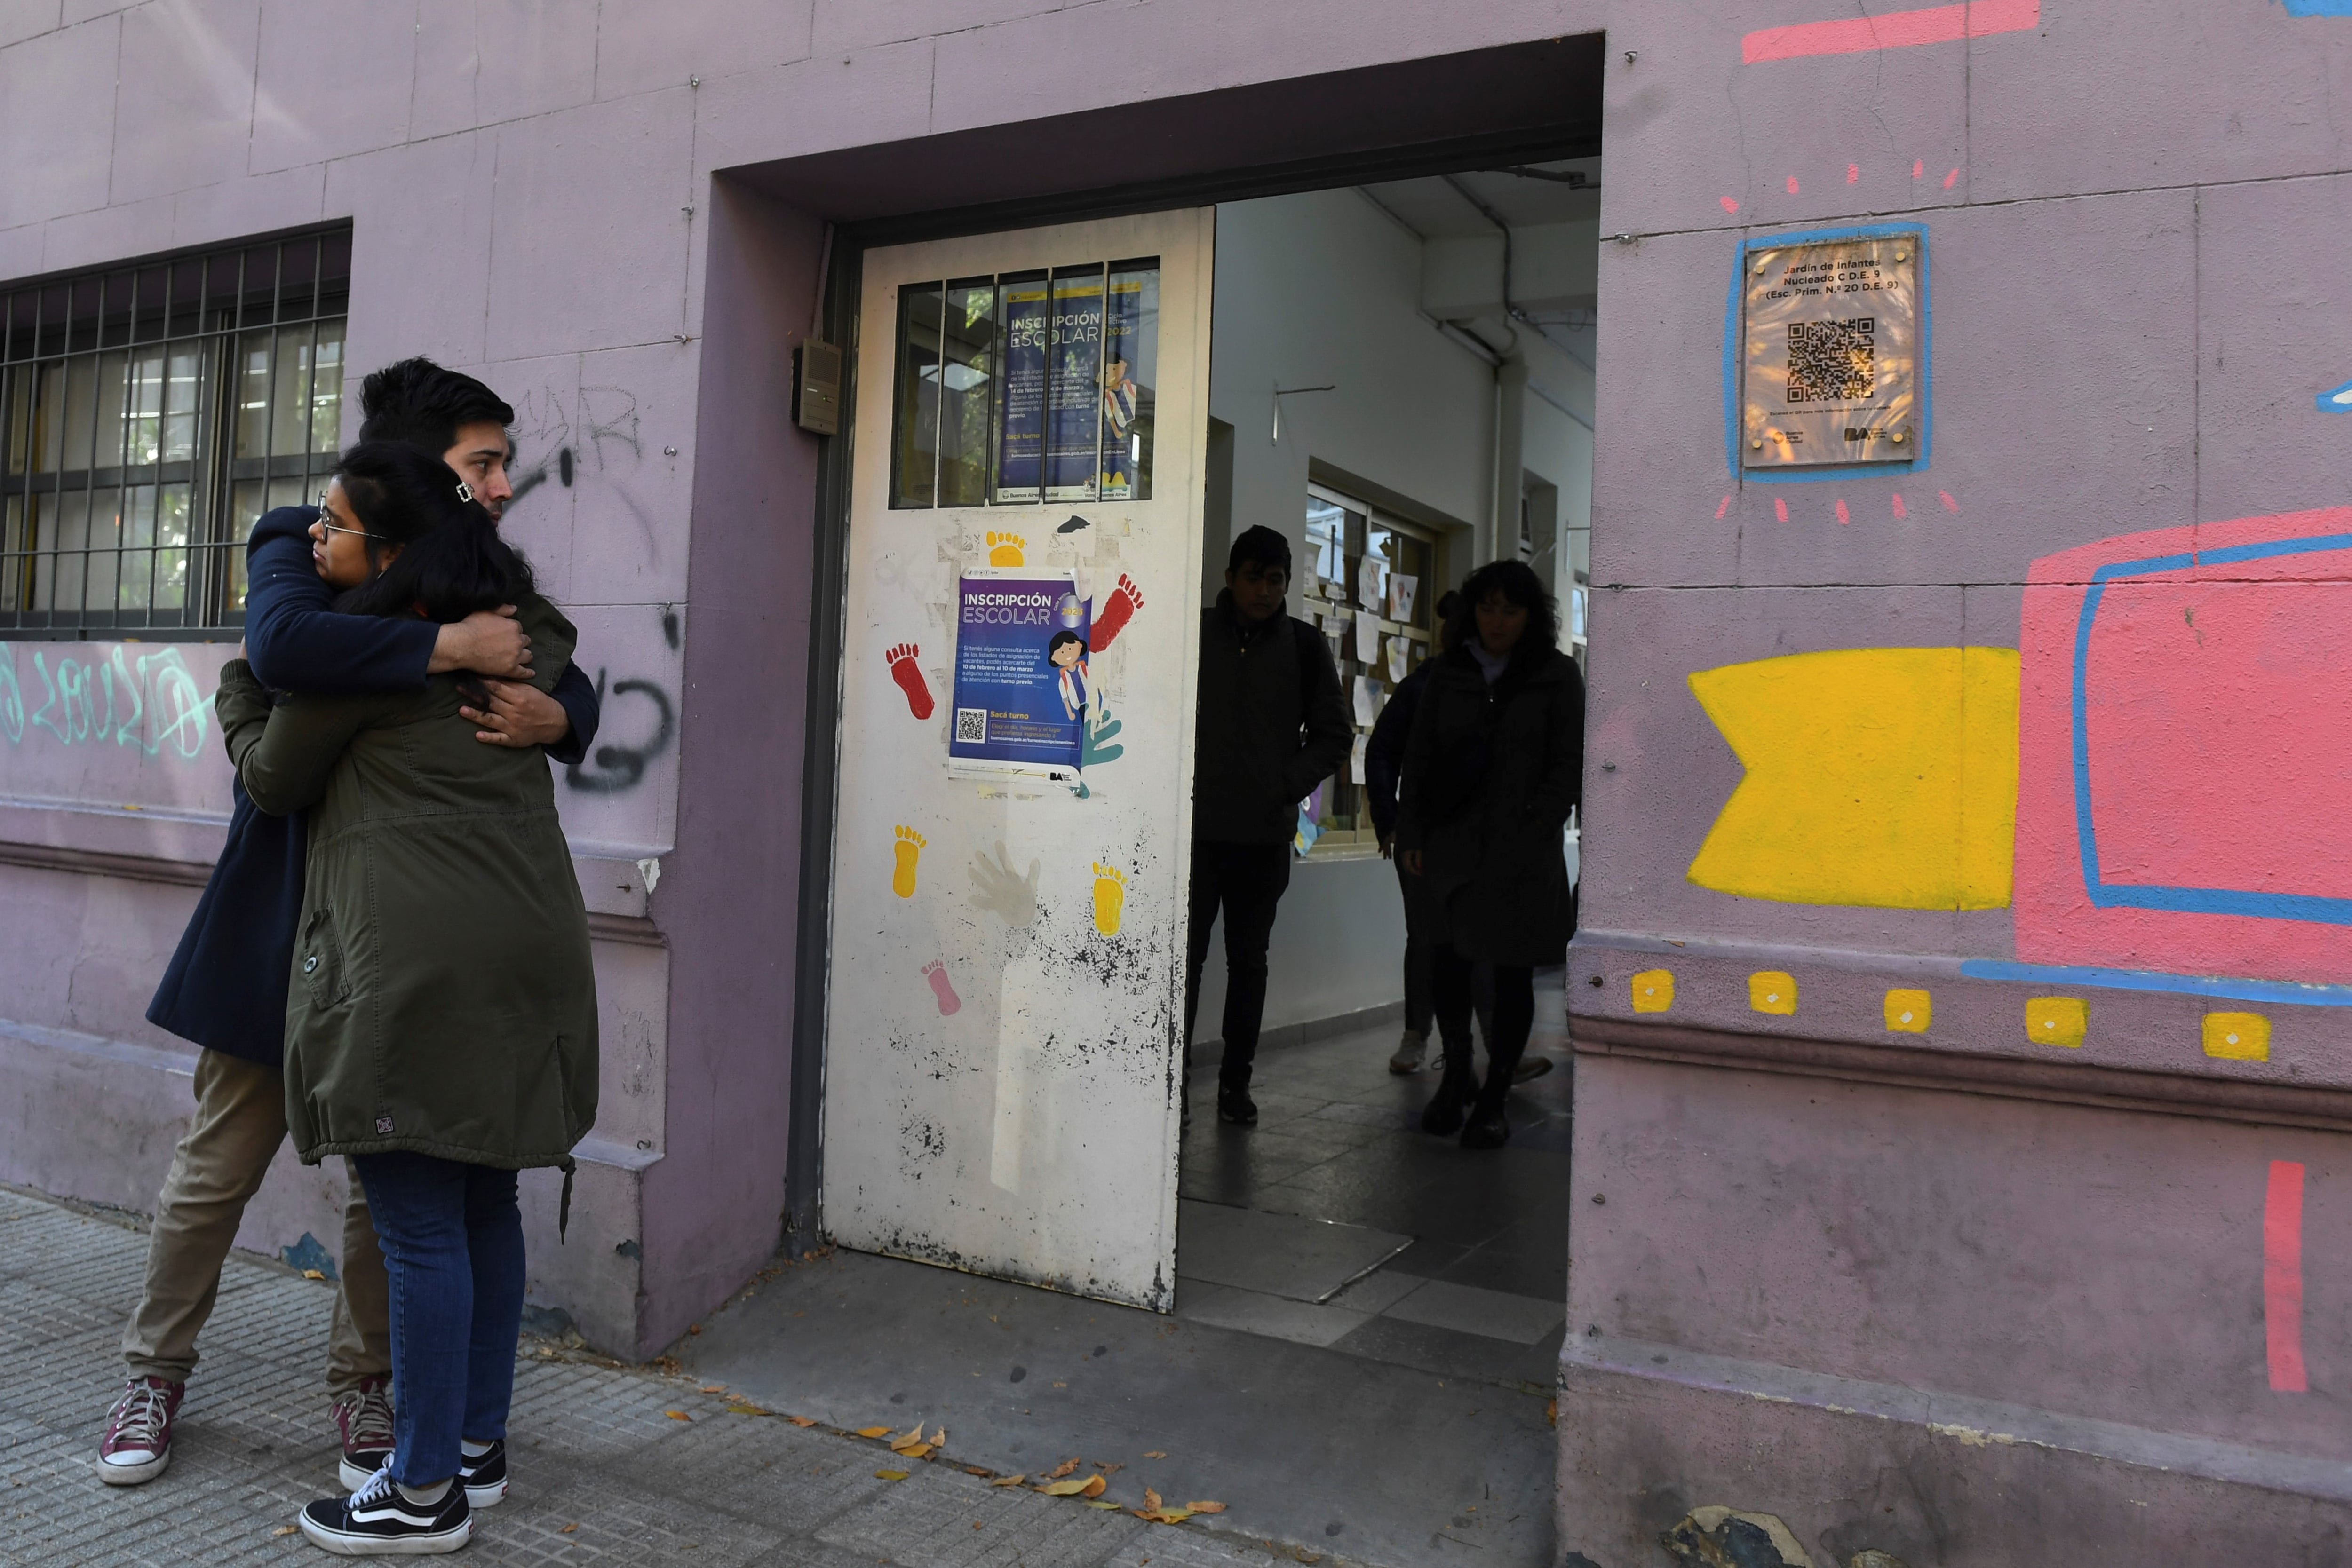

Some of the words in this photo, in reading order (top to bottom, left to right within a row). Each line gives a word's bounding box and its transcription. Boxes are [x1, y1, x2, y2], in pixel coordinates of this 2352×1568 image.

[1784, 263, 1817, 274] Jardín
[1820, 262, 1834, 270] de
[1837, 259, 1881, 269] Infantes
[1784, 274, 1834, 286] Nucleado
[1849, 271, 1870, 280] D.E.
[1874, 270, 1880, 278] 9
[1766, 290, 1791, 300] (Esc.
[1795, 287, 1822, 296] Prim.
[1844, 284, 1859, 293] 20
[1862, 282, 1883, 291] D.E.
[1887, 281, 1899, 290] 9)
[1012, 310, 1099, 330] INSCIPCIÓN
[1010, 326, 1098, 348] ESCOLAR
[1107, 326, 1131, 337] 2022
[965, 592, 1051, 607] INSCRIPCIÓN
[963, 607, 1050, 625] ESCOLAR
[1049, 772, 1063, 782] BA
